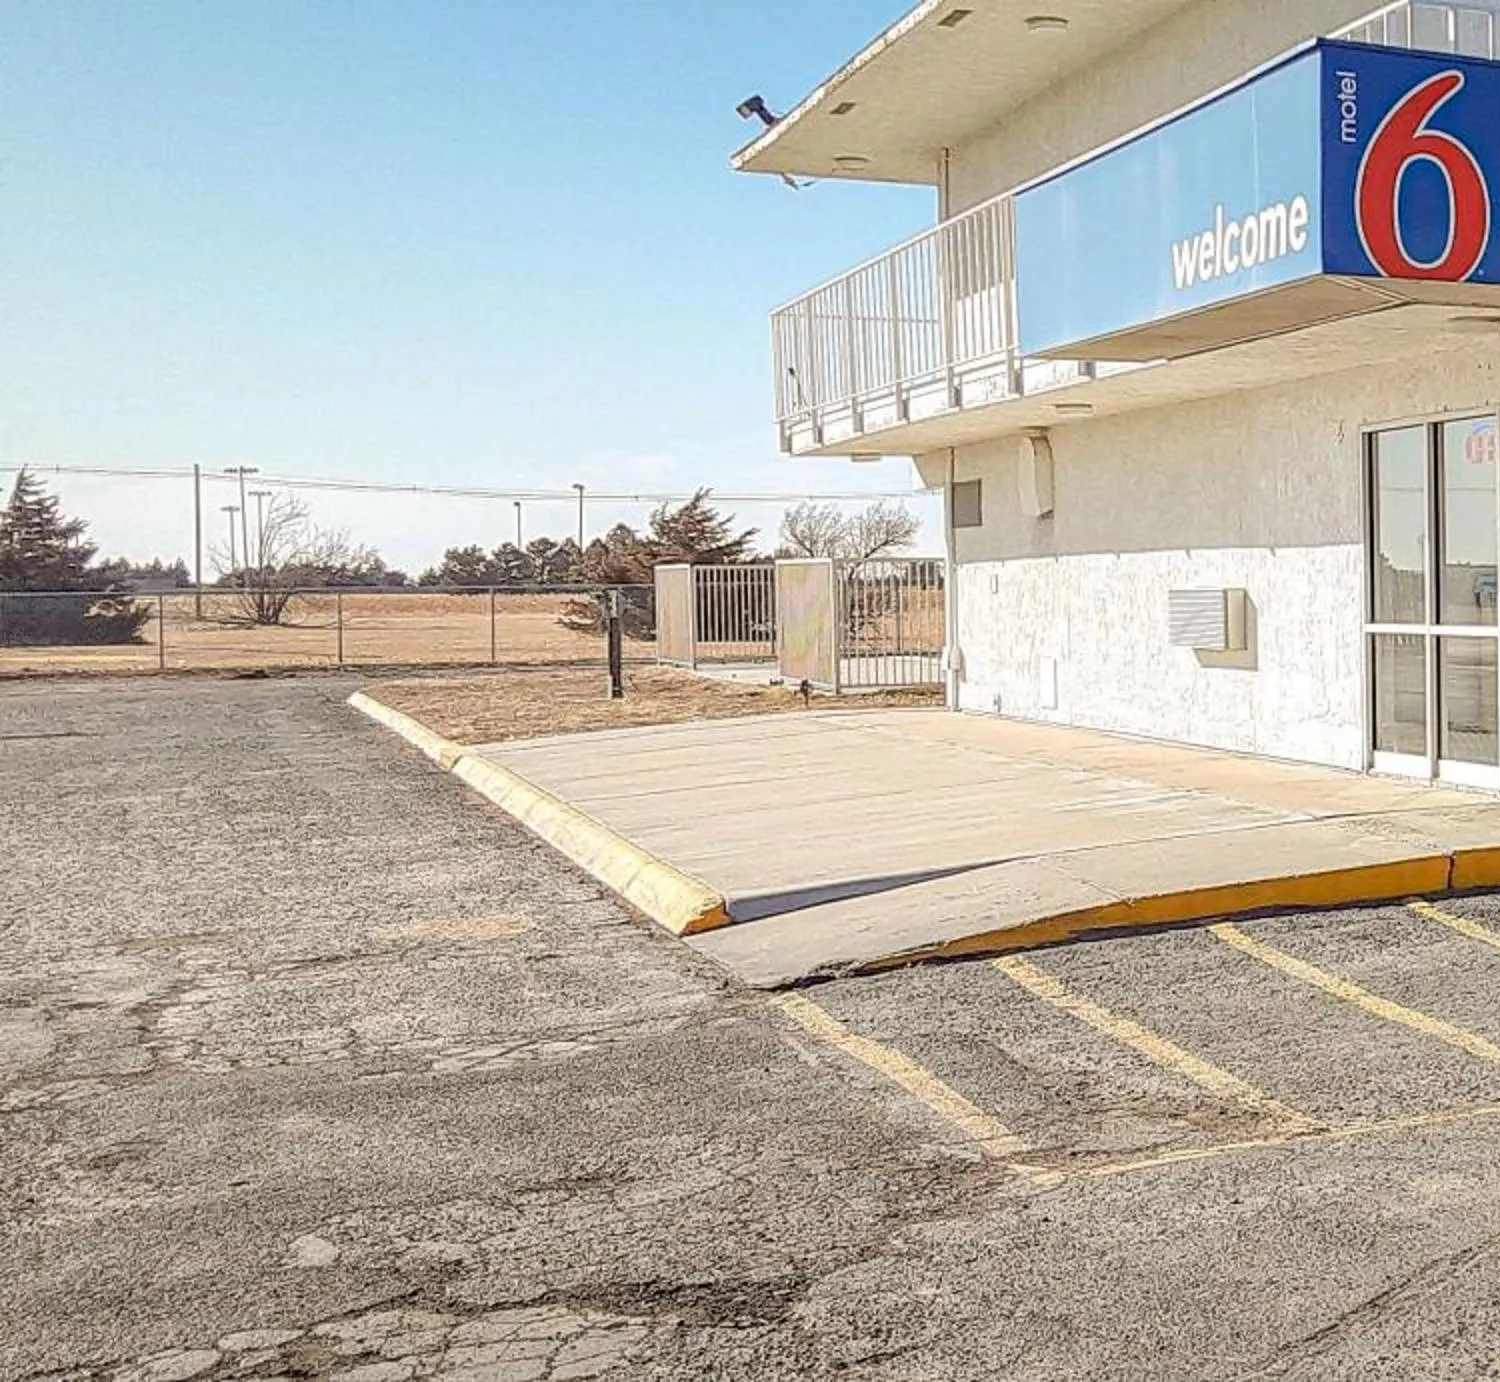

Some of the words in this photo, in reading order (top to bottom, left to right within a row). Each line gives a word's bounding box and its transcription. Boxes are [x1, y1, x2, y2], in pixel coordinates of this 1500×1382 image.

[1336, 71, 1357, 143] motel
[1354, 69, 1491, 283] 6
[1172, 195, 1309, 289] welcome
